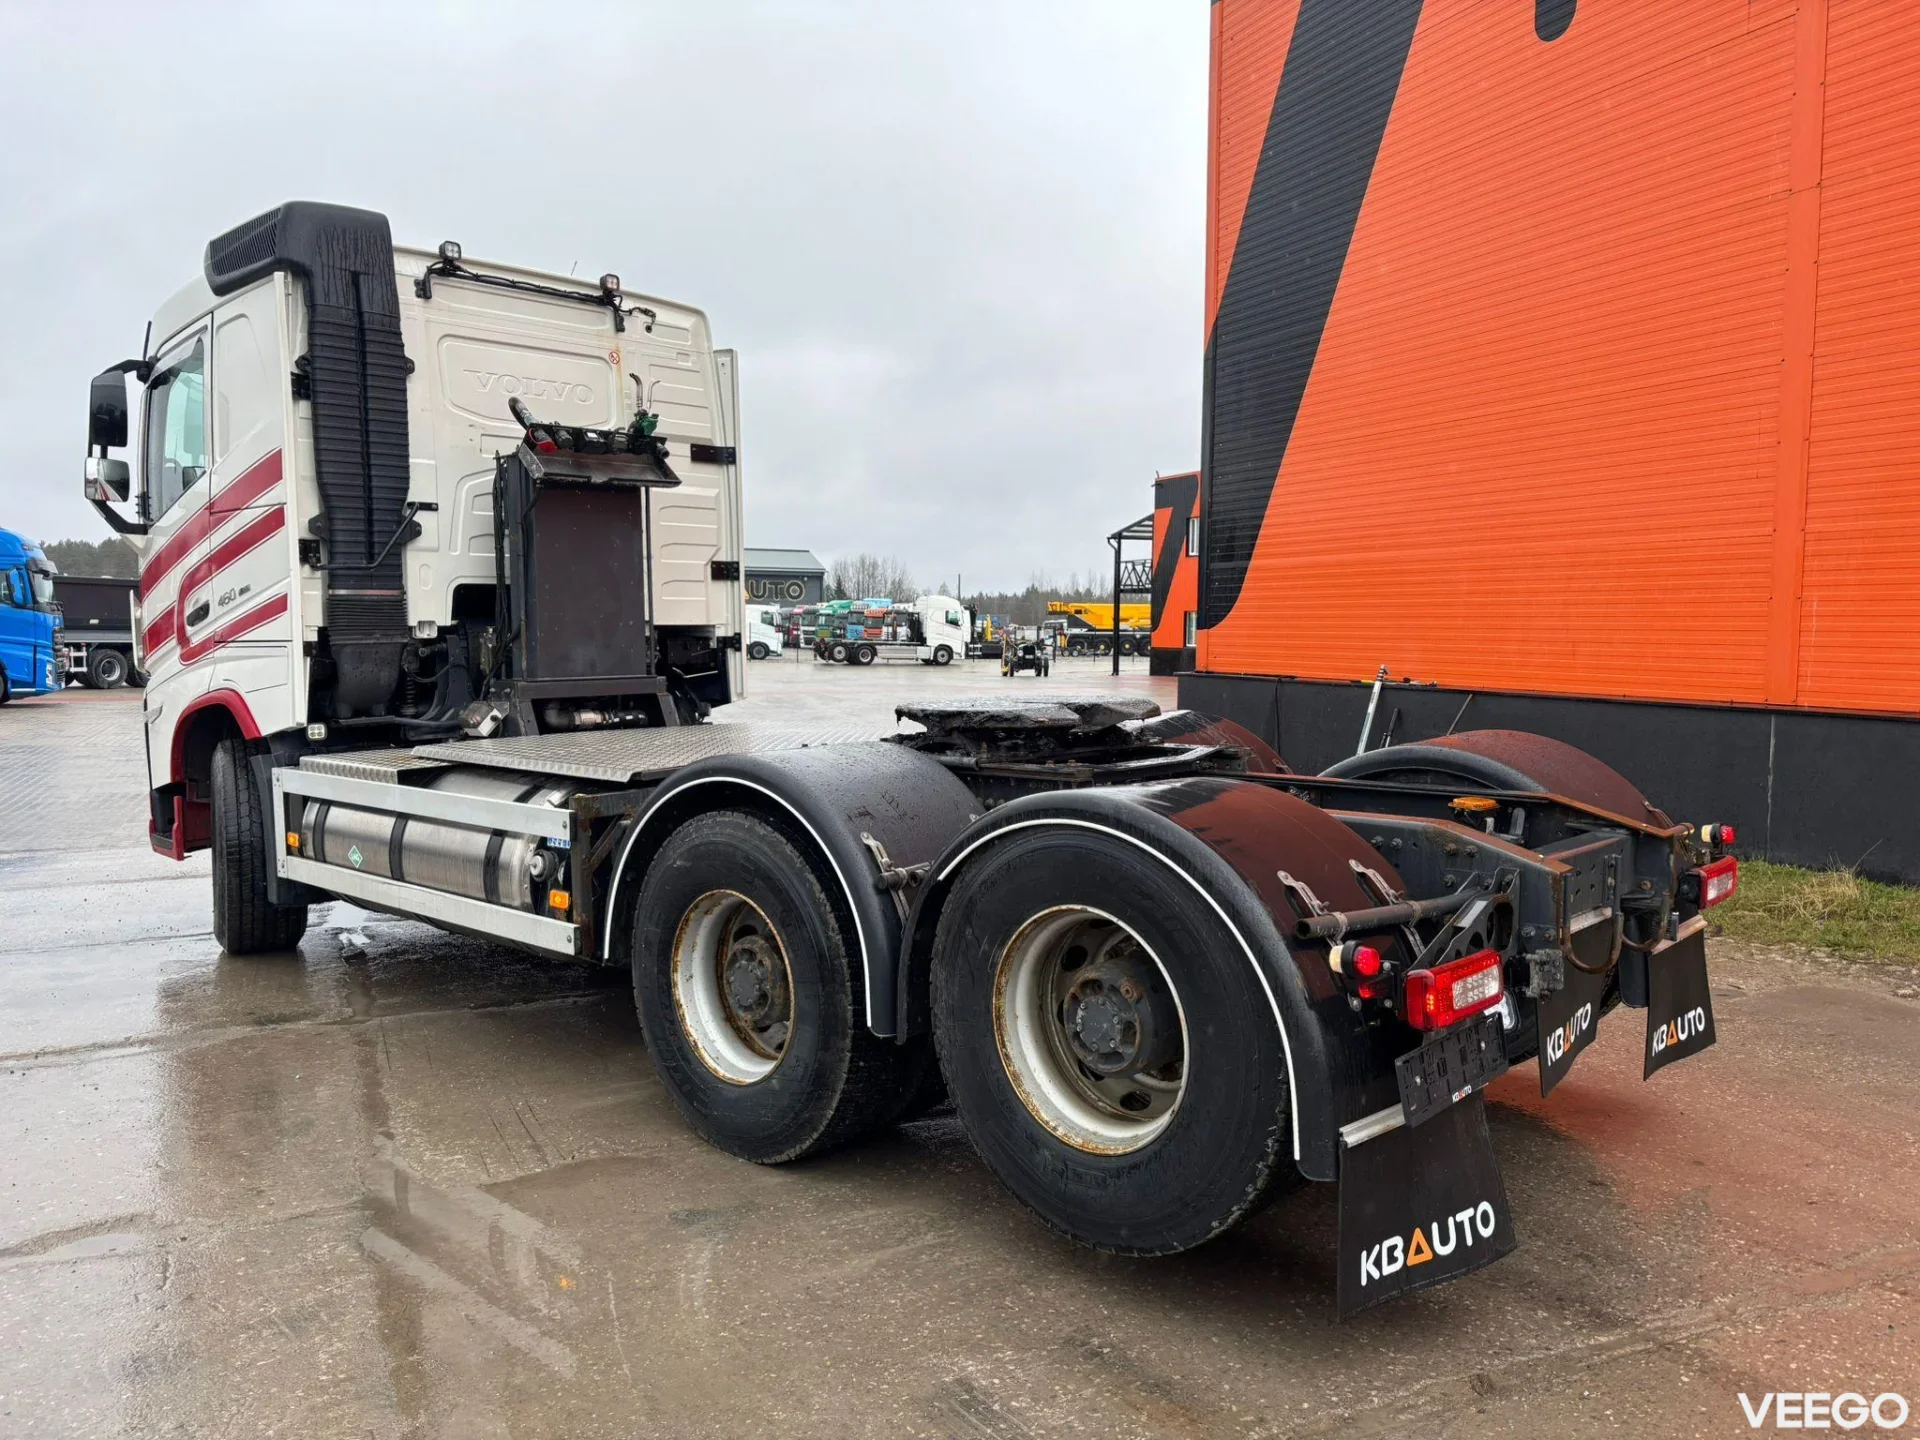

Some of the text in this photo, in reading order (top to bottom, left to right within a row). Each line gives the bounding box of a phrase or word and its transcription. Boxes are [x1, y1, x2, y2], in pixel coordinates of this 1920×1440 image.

[463, 369, 595, 405] VOLVO
[218, 588, 236, 607] 460
[1547, 1002, 1592, 1066] KBAUTO
[1652, 1006, 1706, 1057] KBAUTO
[1361, 1201, 1495, 1286] KBAUTO
